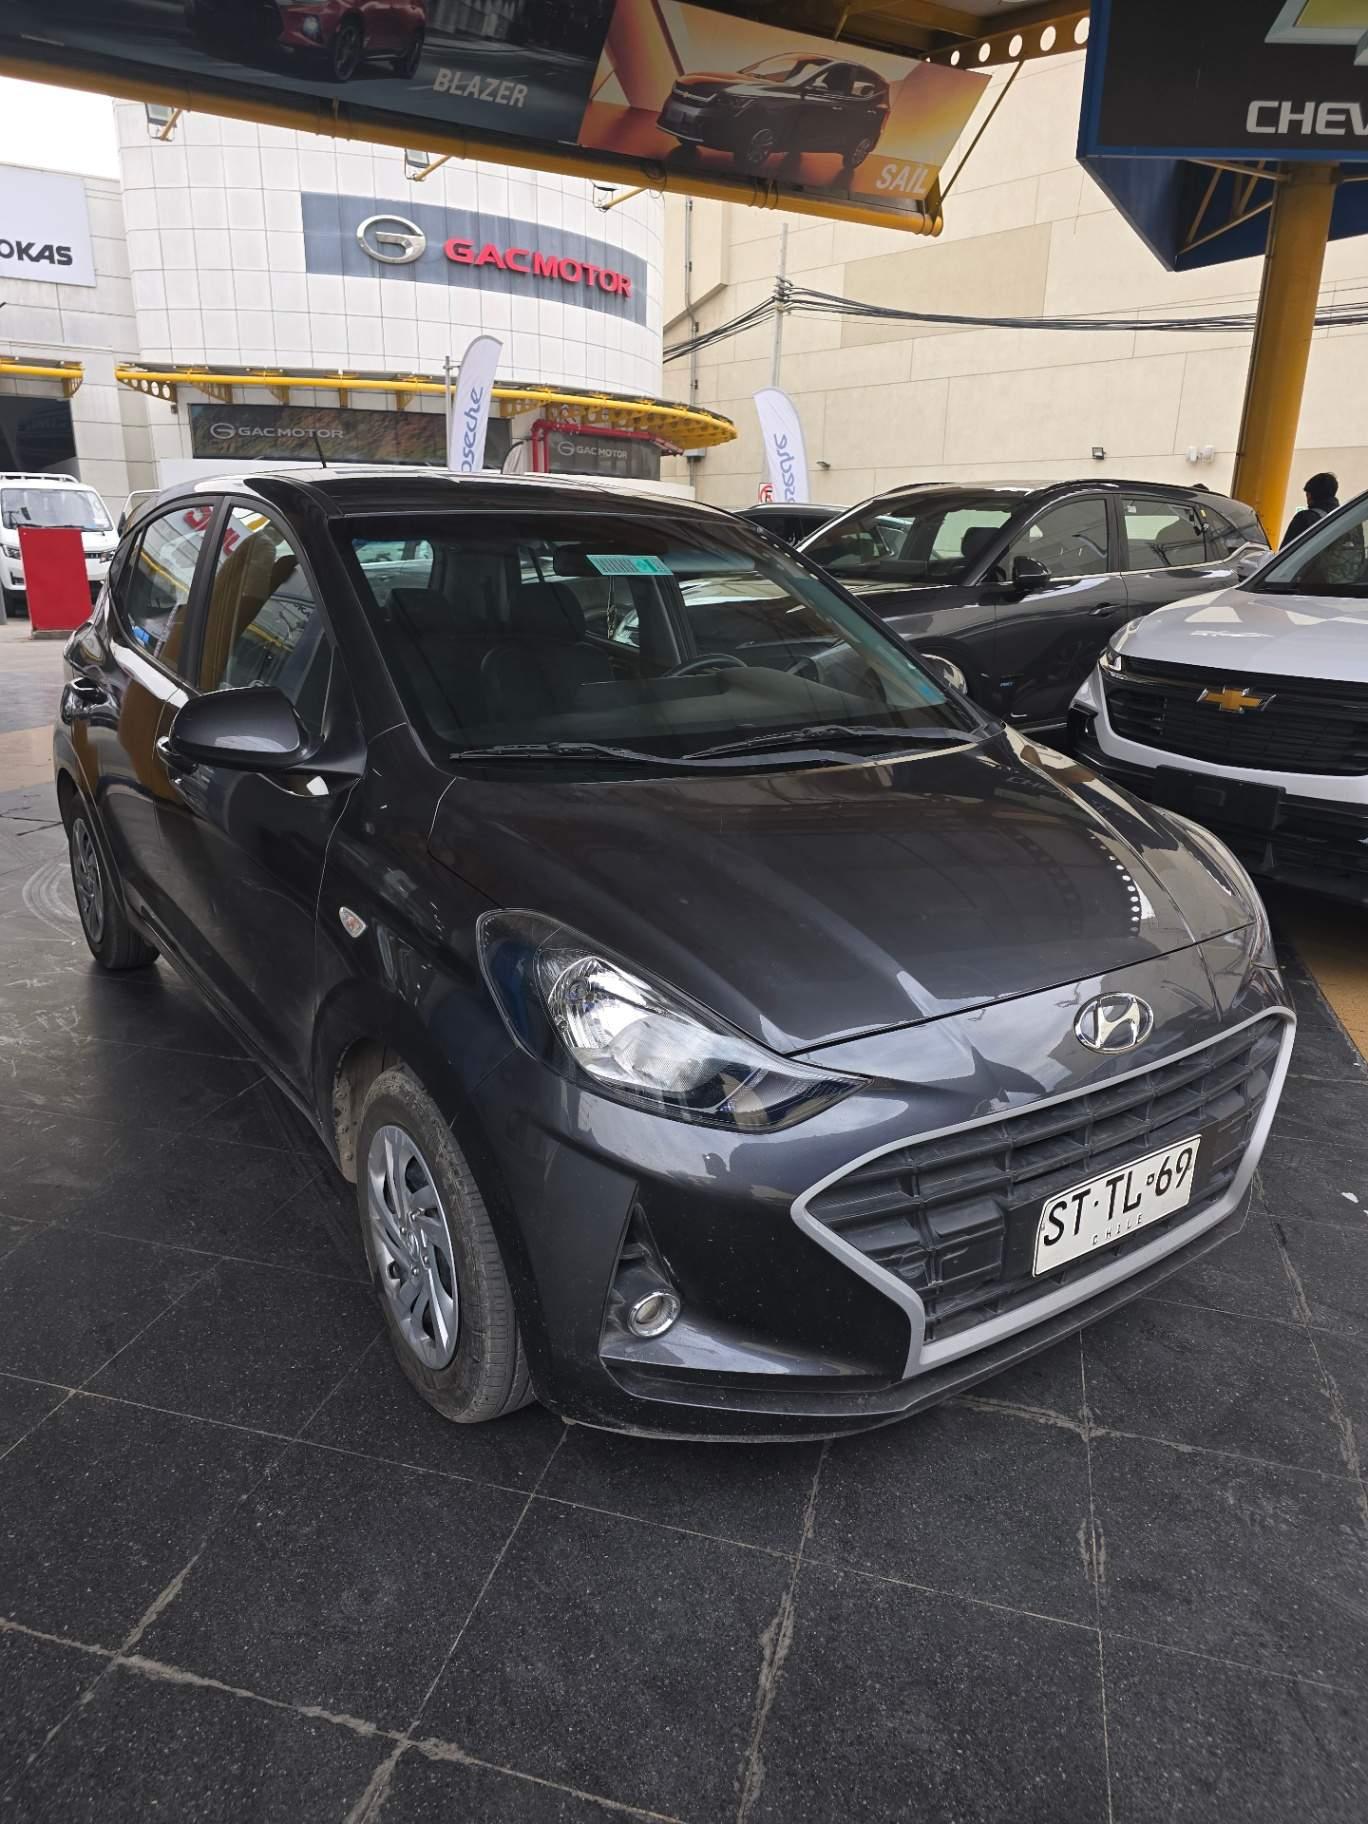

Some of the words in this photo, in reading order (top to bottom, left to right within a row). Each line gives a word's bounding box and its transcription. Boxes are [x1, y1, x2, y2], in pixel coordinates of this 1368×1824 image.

[433, 67, 528, 108] BLAZER
[876, 163, 929, 194] SAIL
[0, 238, 73, 266] OKAS
[1092, 1213, 1143, 1246] CHILE
